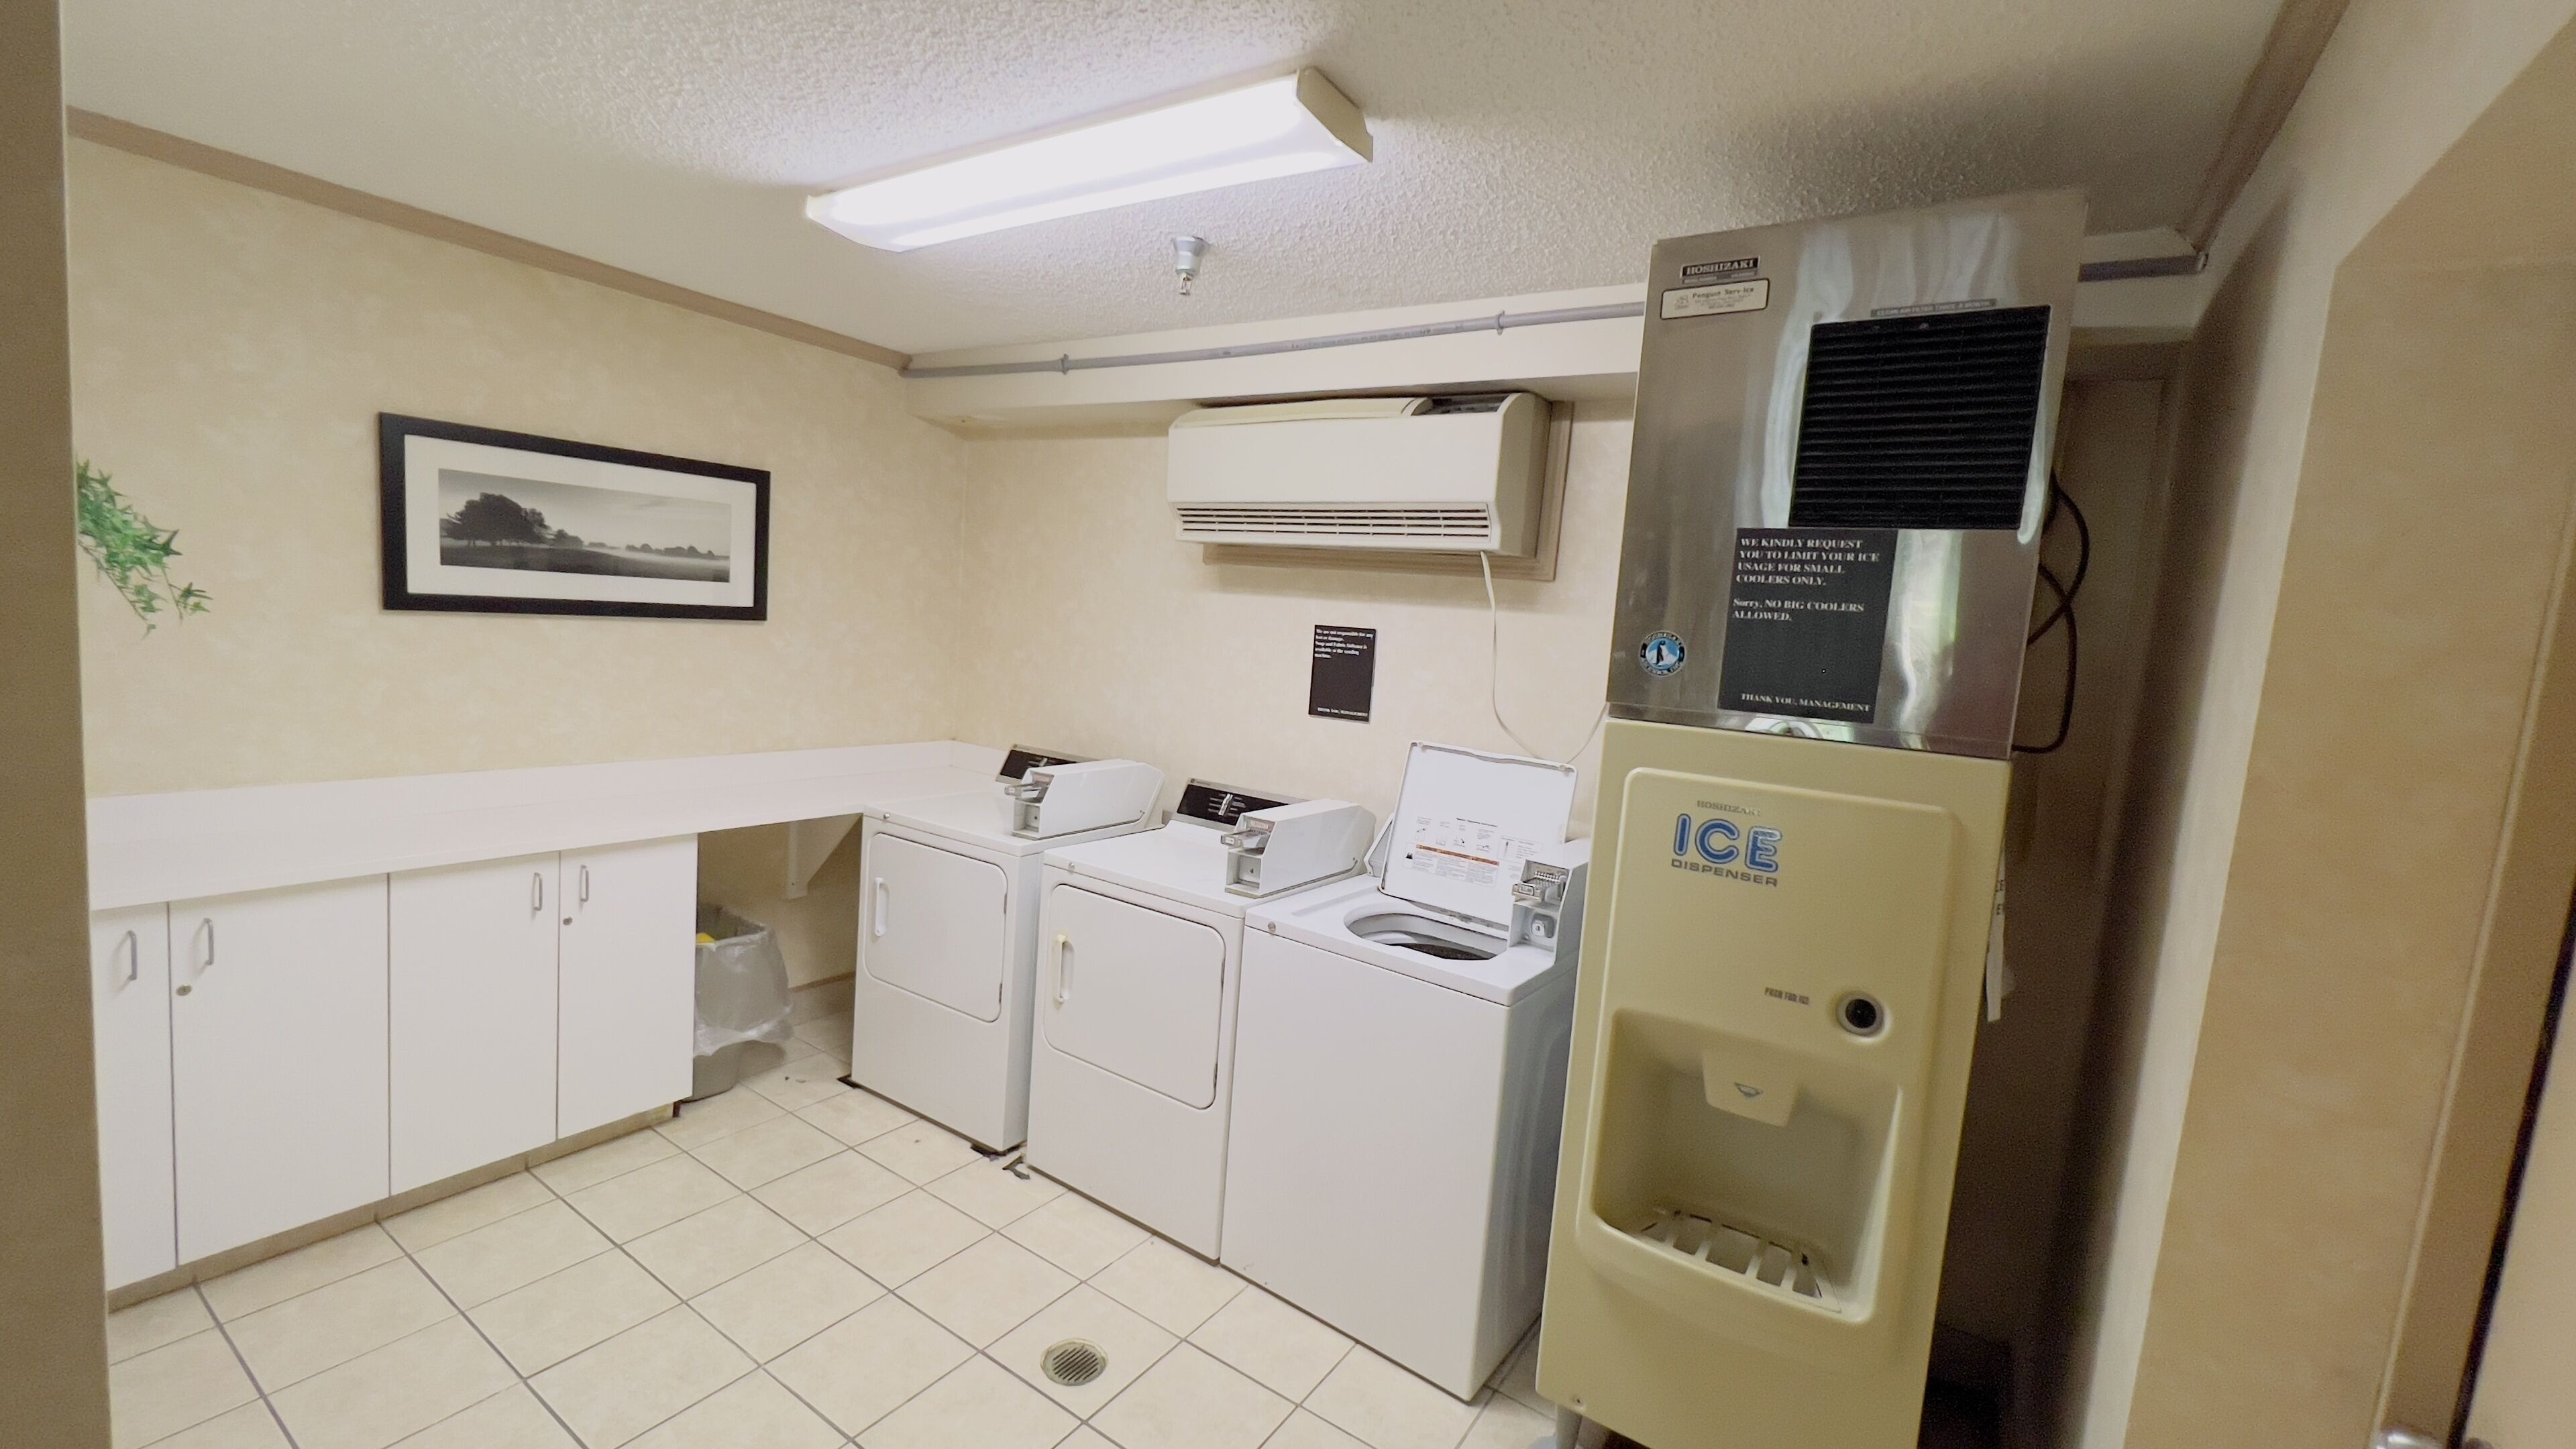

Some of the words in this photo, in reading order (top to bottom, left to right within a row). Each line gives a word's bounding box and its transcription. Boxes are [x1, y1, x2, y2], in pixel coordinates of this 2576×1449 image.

[1686, 260, 1754, 274] HOSHIZAKI
[1741, 538, 1758, 547] WE
[1761, 538, 1805, 548] KINDLY
[1807, 539, 1863, 549] REQUEST
[1739, 550, 1763, 559] YOU
[1766, 551, 1782, 559] TO
[1784, 551, 1819, 560] LIMIT
[1821, 552, 1854, 561] YOUR
[1858, 553, 1880, 562] ICE
[1737, 562, 1774, 572] USAGE
[1778, 564, 1801, 572] FOR
[1803, 564, 1845, 574] SMALL
[1736, 574, 1790, 584] COOLERS
[1792, 576, 1827, 586] ONLY.
[1765, 600, 1782, 608] NO
[1784, 600, 1804, 609] BIG
[1807, 602, 1865, 612] COOLERS
[1733, 610, 1792, 621] ALLOWED.
[1741, 693, 1772, 703] THANK
[1800, 698, 1871, 712] MANAGEMENT
[1697, 800, 1760, 816] HOSHIZAKI
[1674, 813, 1782, 873] ICE
[1671, 858, 1778, 887] DISPENSER
